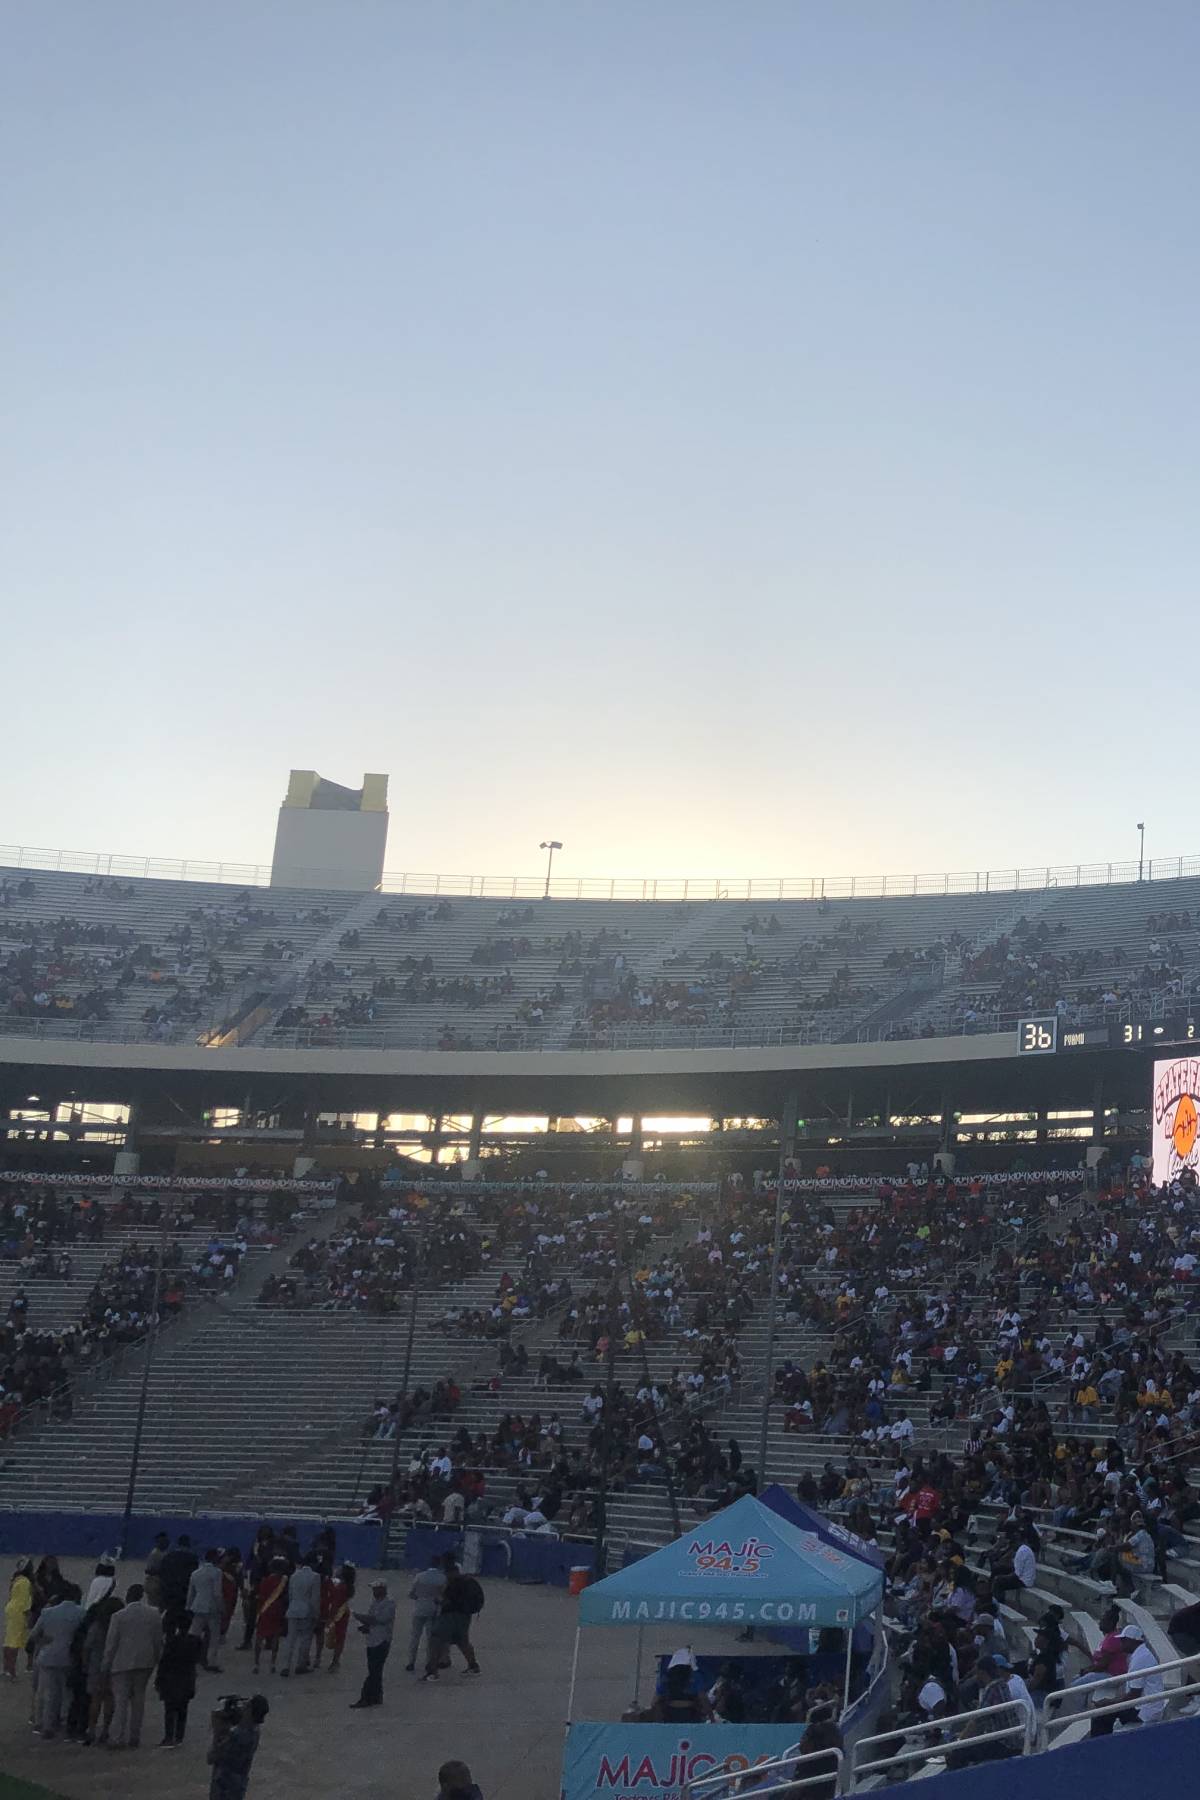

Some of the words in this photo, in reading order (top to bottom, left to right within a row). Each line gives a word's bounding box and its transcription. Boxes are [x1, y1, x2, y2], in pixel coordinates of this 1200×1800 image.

[1025, 1024, 1051, 1050] 36
[1124, 1025, 1142, 1042] 31
[1187, 1025, 1195, 1038] 2
[1155, 1059, 1188, 1126] STATE
[696, 1555, 760, 1572] 94.5
[612, 1600, 816, 1620] MAJIC945.COM
